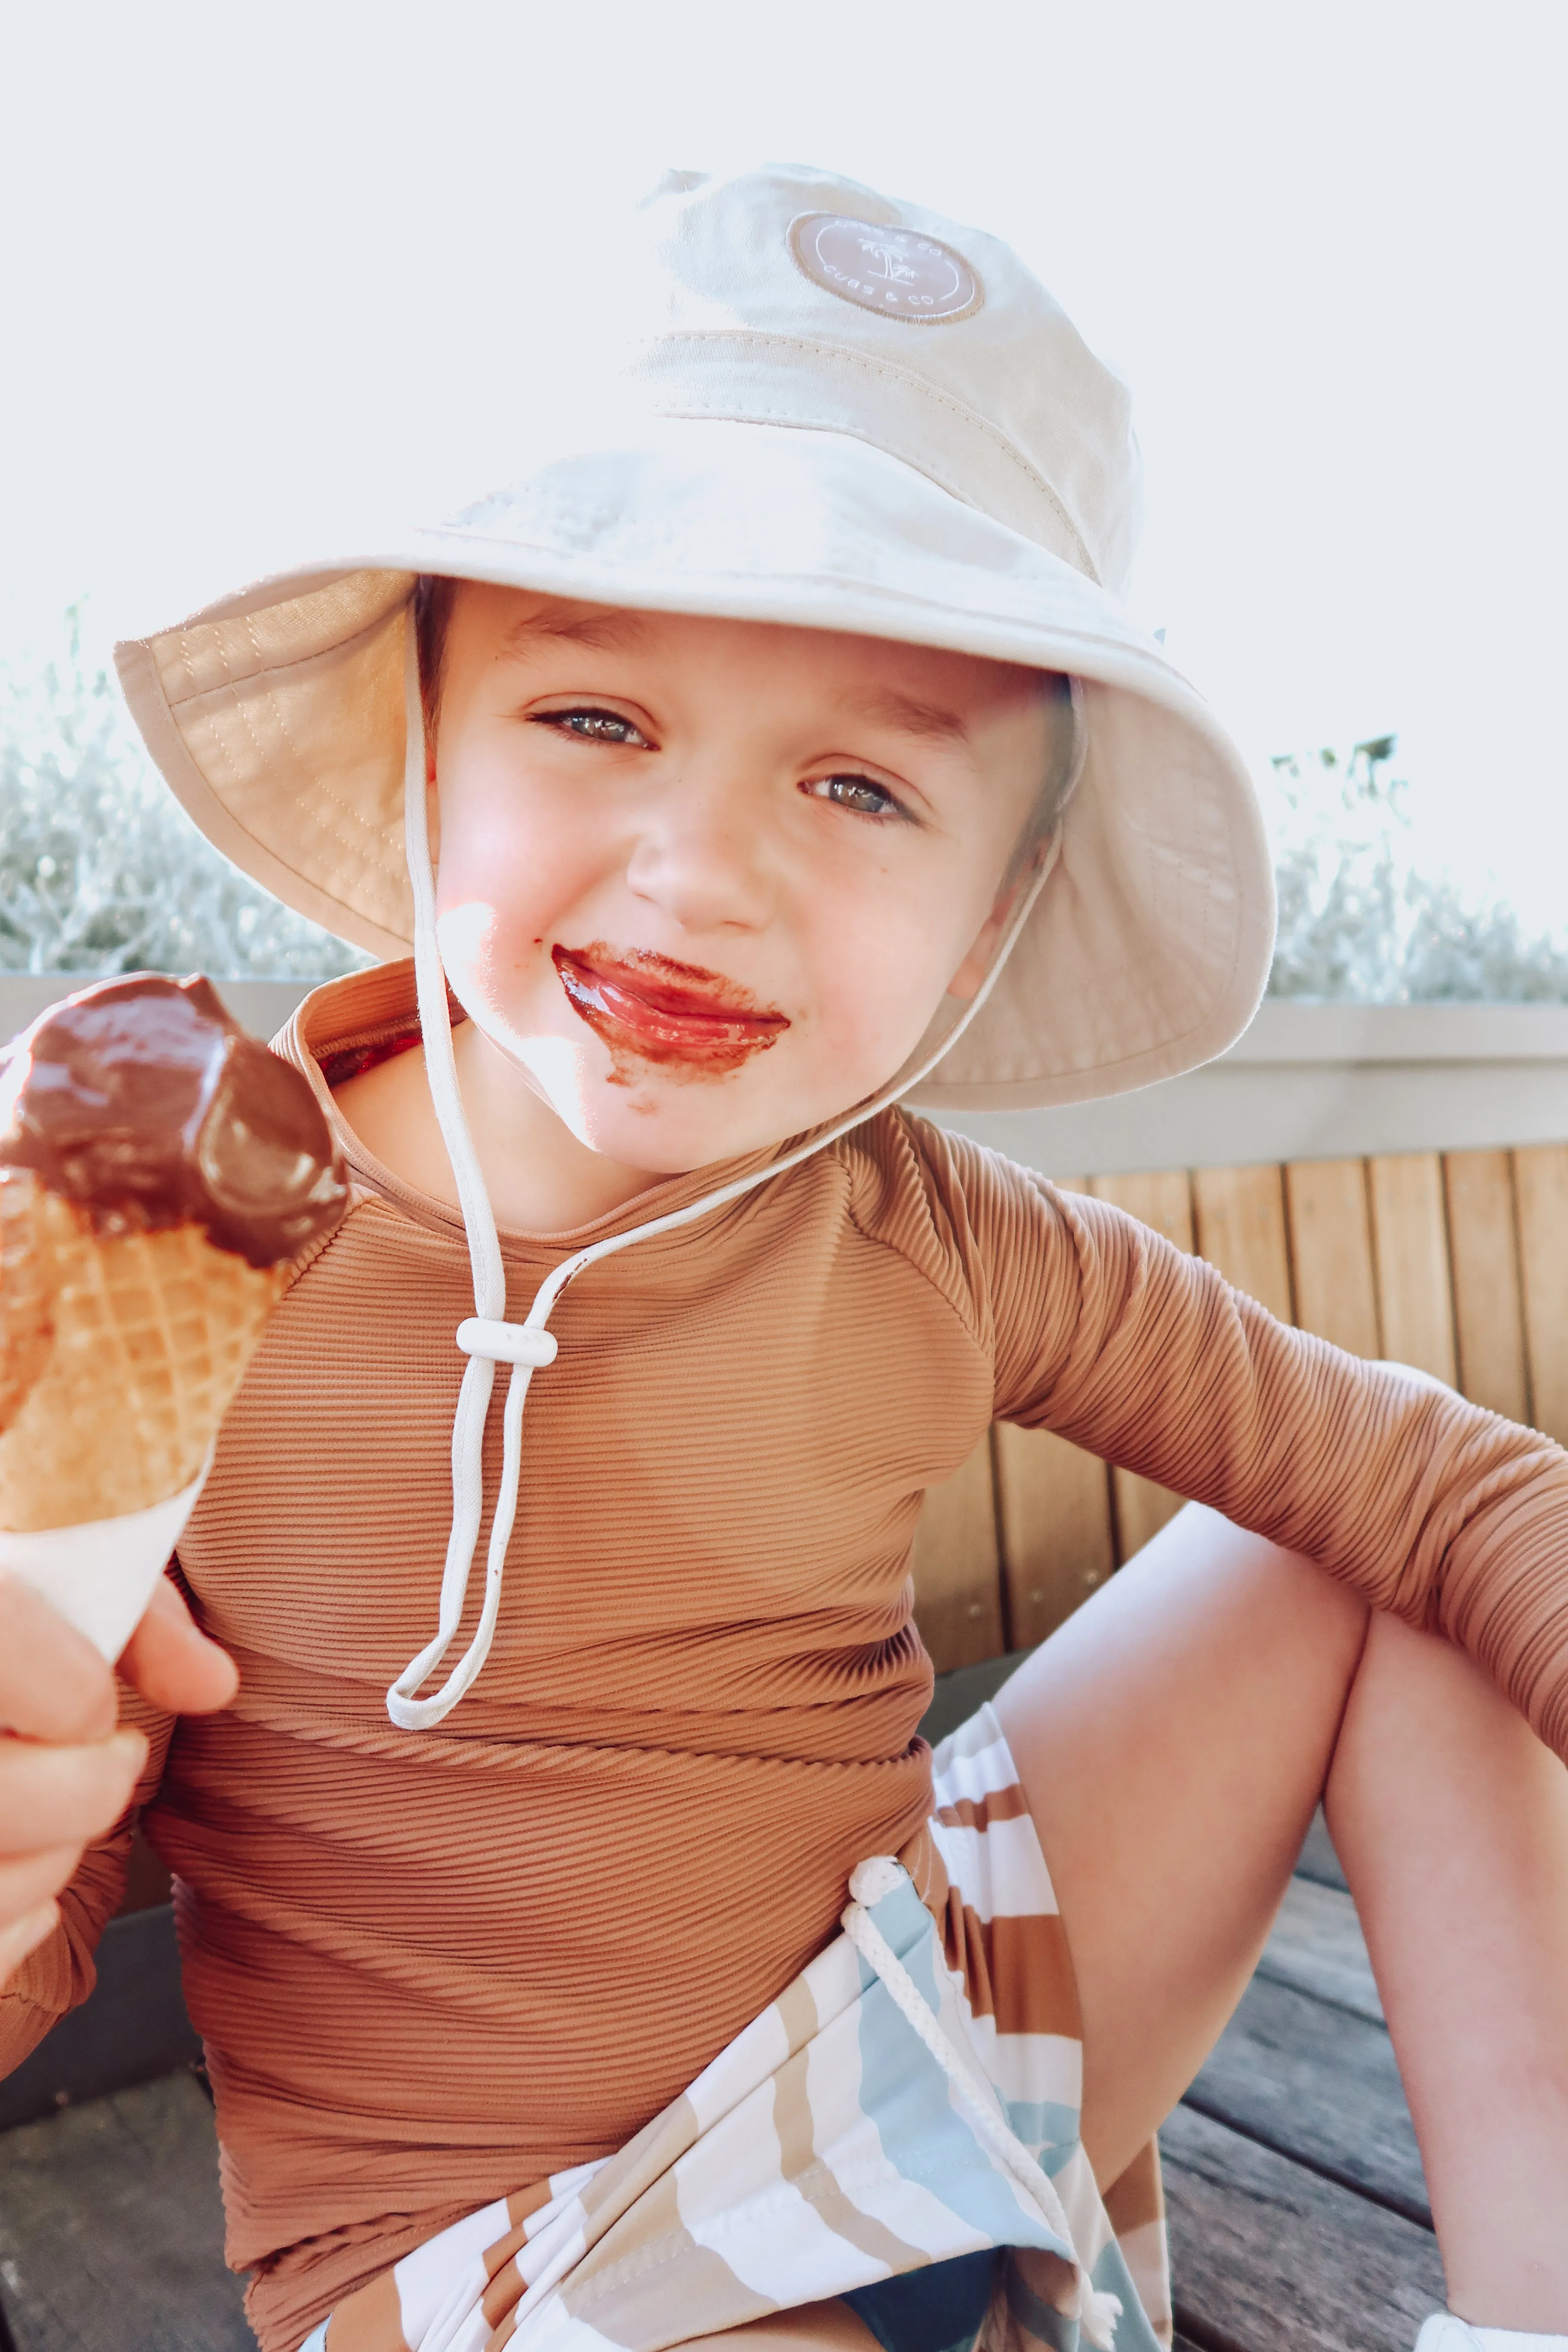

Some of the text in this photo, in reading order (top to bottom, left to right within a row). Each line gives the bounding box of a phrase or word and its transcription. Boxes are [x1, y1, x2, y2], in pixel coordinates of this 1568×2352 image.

[823, 265, 934, 306] CUBS & CO
